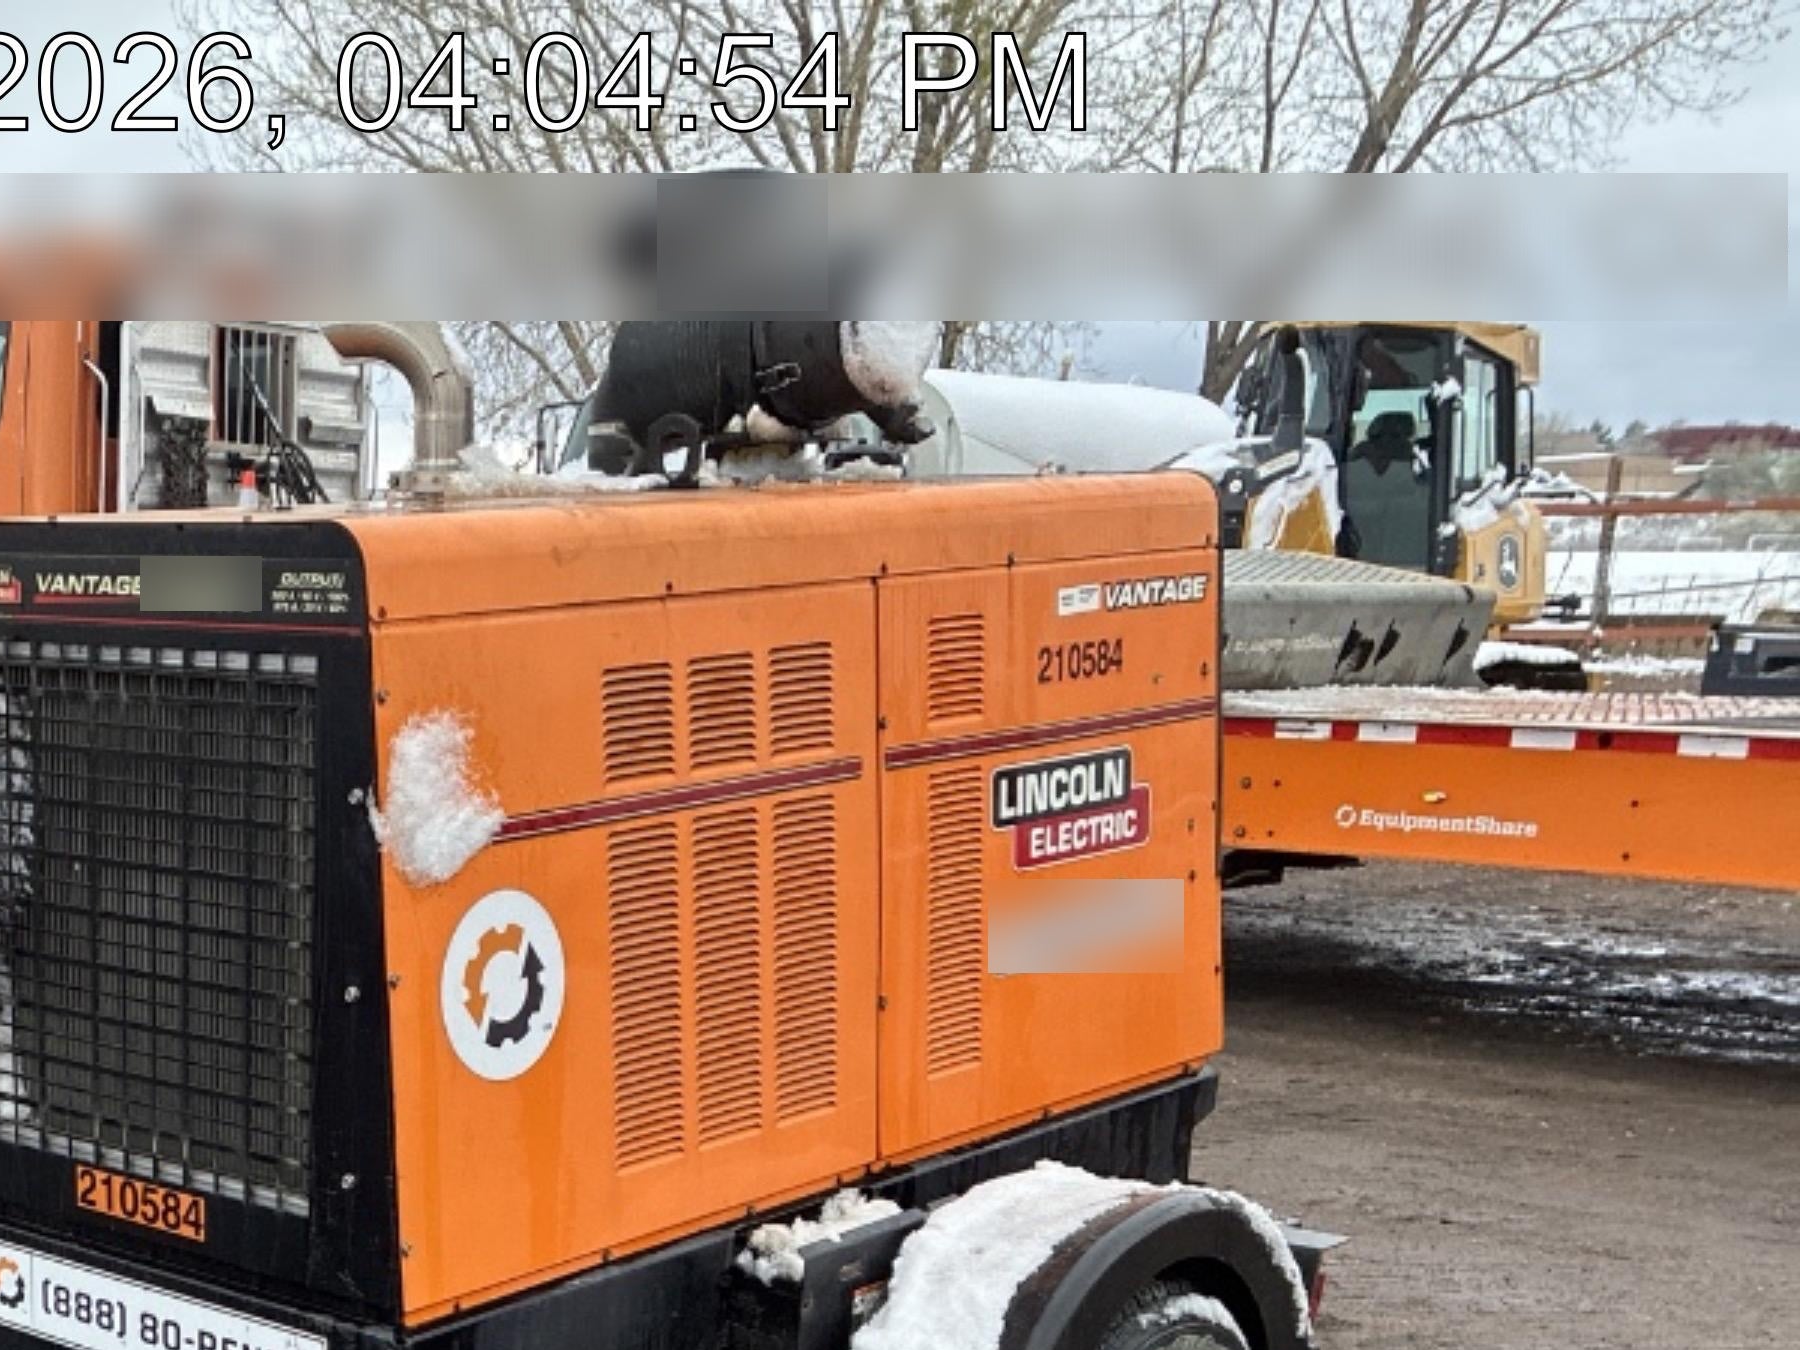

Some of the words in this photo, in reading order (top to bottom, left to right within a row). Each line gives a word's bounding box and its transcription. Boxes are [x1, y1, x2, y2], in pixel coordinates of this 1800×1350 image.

[1103, 574, 1208, 611] VANTAGE
[1037, 638, 1124, 685] 210584
[999, 757, 1125, 819] LINCOLN
[1030, 808, 1138, 859] ELECTRIC
[1359, 808, 1538, 838] EquipmentShare
[79, 1169, 201, 1238] 210584
[41, 1278, 127, 1339] (888)
